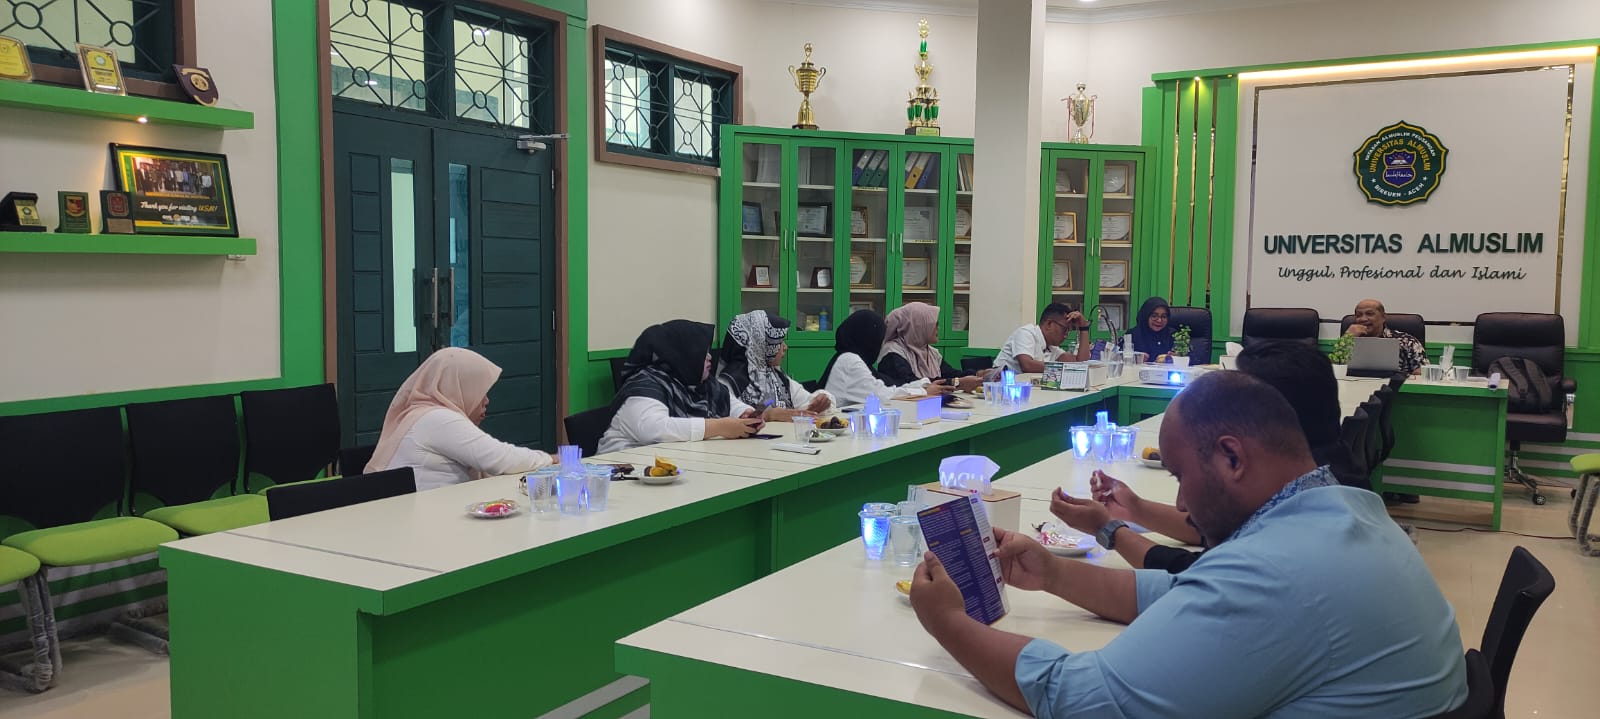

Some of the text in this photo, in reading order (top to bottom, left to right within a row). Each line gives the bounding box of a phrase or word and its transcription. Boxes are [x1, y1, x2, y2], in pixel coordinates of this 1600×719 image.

[1369, 139, 1430, 172] UNIVERSITAS ALMUSLIM
[1374, 184, 1401, 197] BIREUEN
[1408, 183, 1424, 195] ACEH
[140, 201, 158, 210] Thank
[158, 204, 168, 212] you
[168, 202, 178, 212] for
[1264, 232, 1543, 254] UNIVERSITAS ALMUSLIM
[1278, 265, 1527, 281] Unggul, Profesional dan Islami
